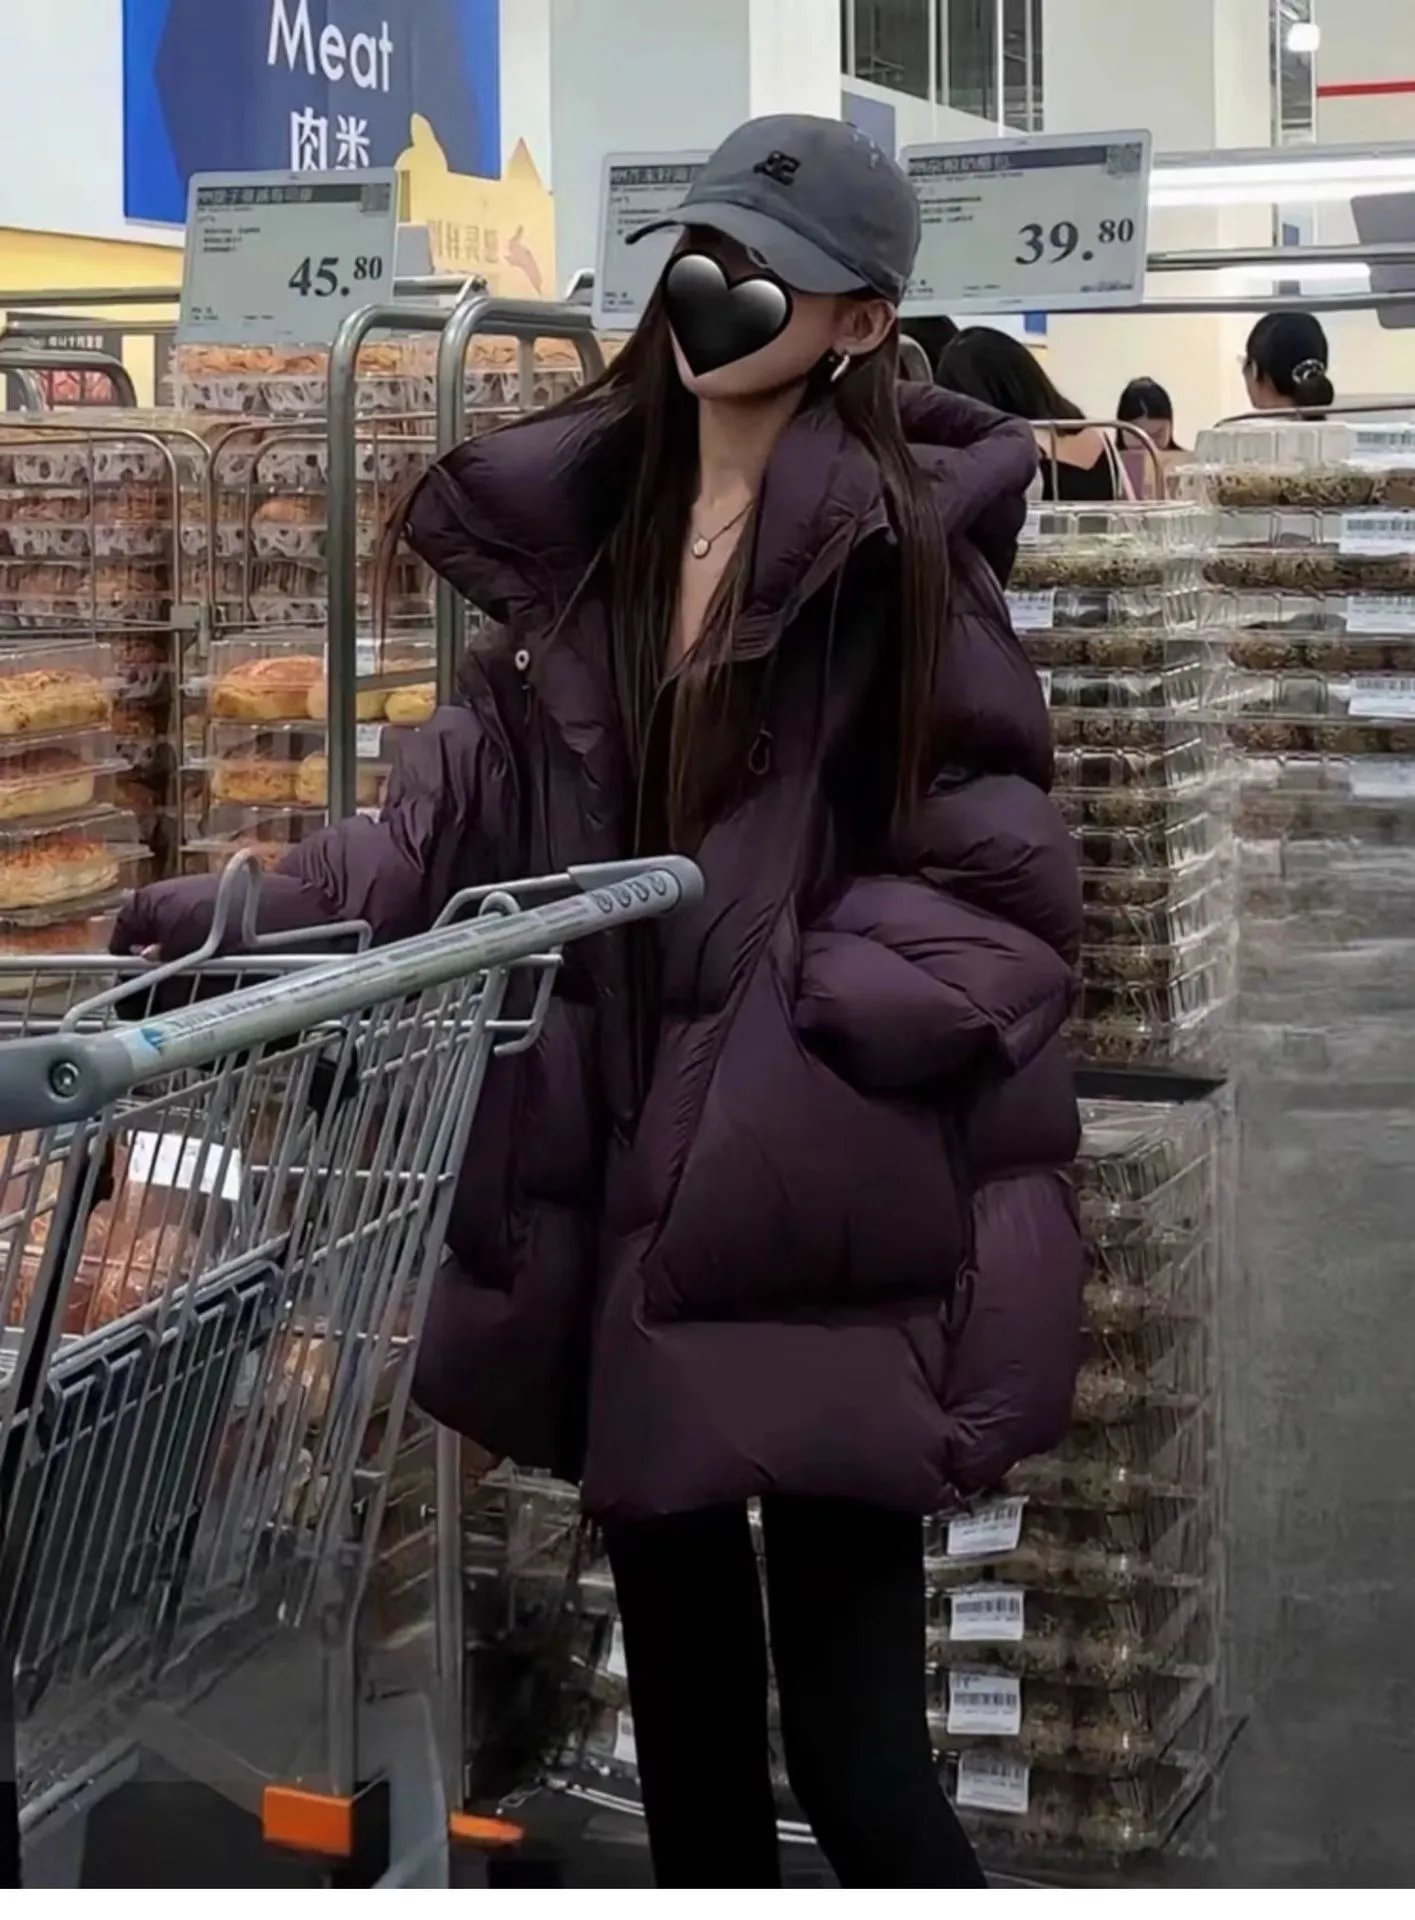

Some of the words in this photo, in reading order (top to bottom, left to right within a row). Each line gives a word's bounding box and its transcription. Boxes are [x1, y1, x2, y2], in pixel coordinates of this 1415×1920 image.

[267, 0, 393, 93] Meat
[1015, 218, 1134, 265] 39.80
[288, 256, 382, 297] 45.80
